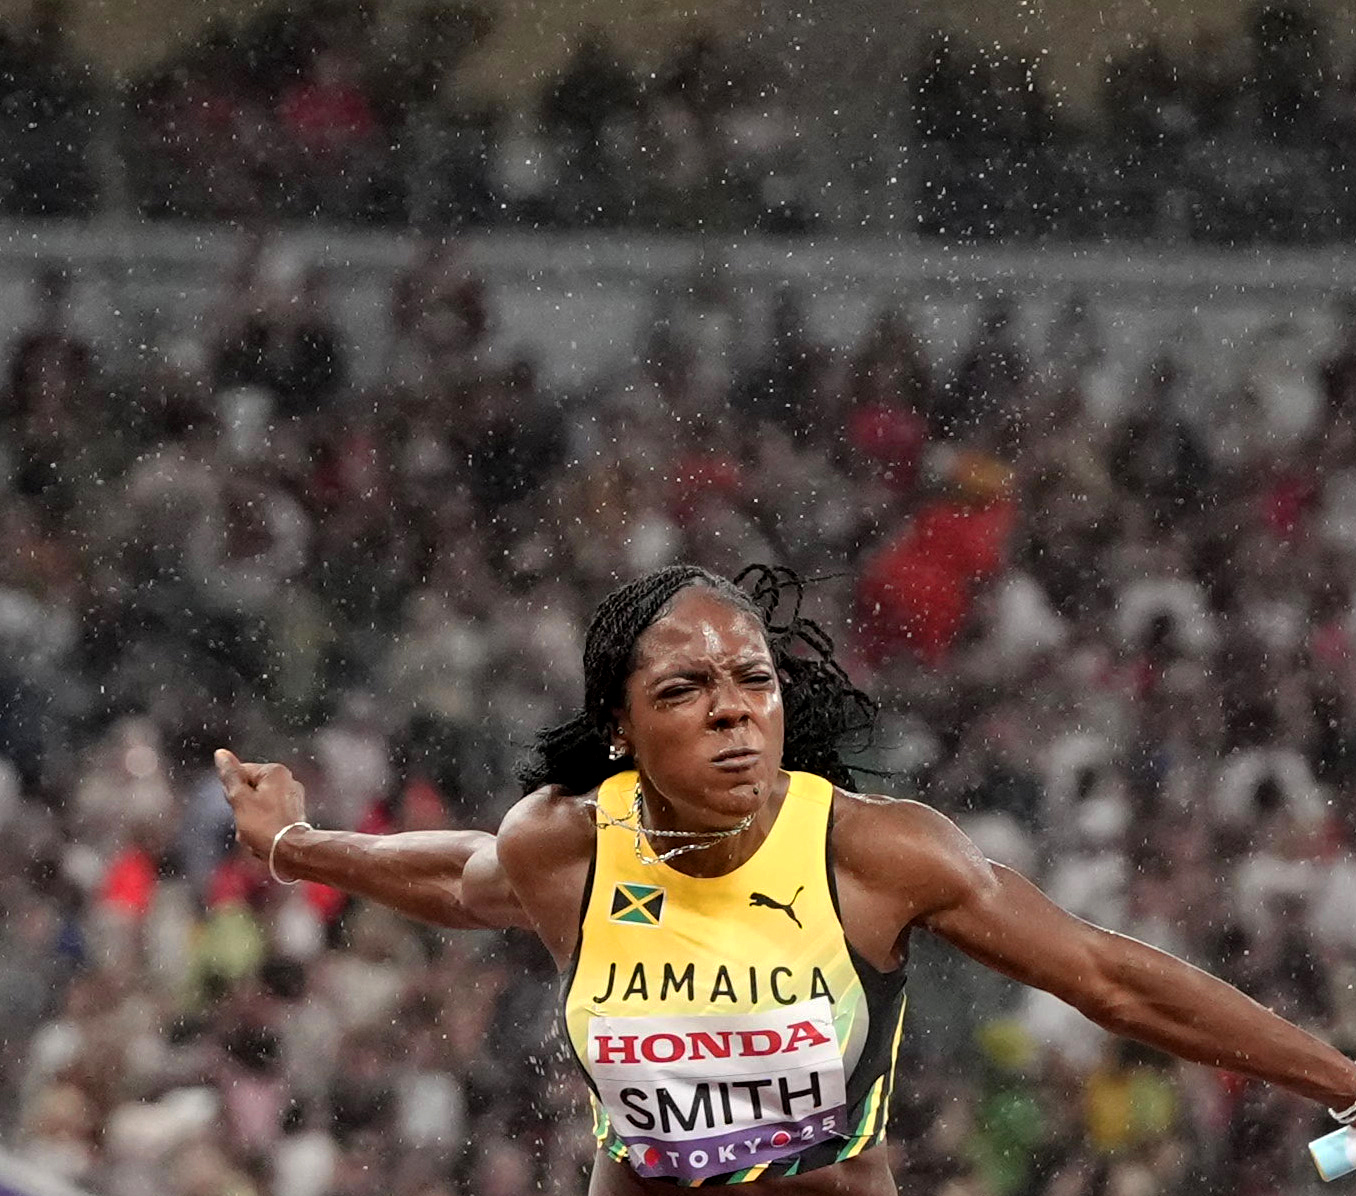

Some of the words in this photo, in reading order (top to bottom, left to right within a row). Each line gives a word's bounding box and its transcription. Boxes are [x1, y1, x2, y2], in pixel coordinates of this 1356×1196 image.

[592, 962, 836, 1006] JAMAICA
[594, 1020, 830, 1064] HONDA
[619, 1071, 825, 1135] SMITH
